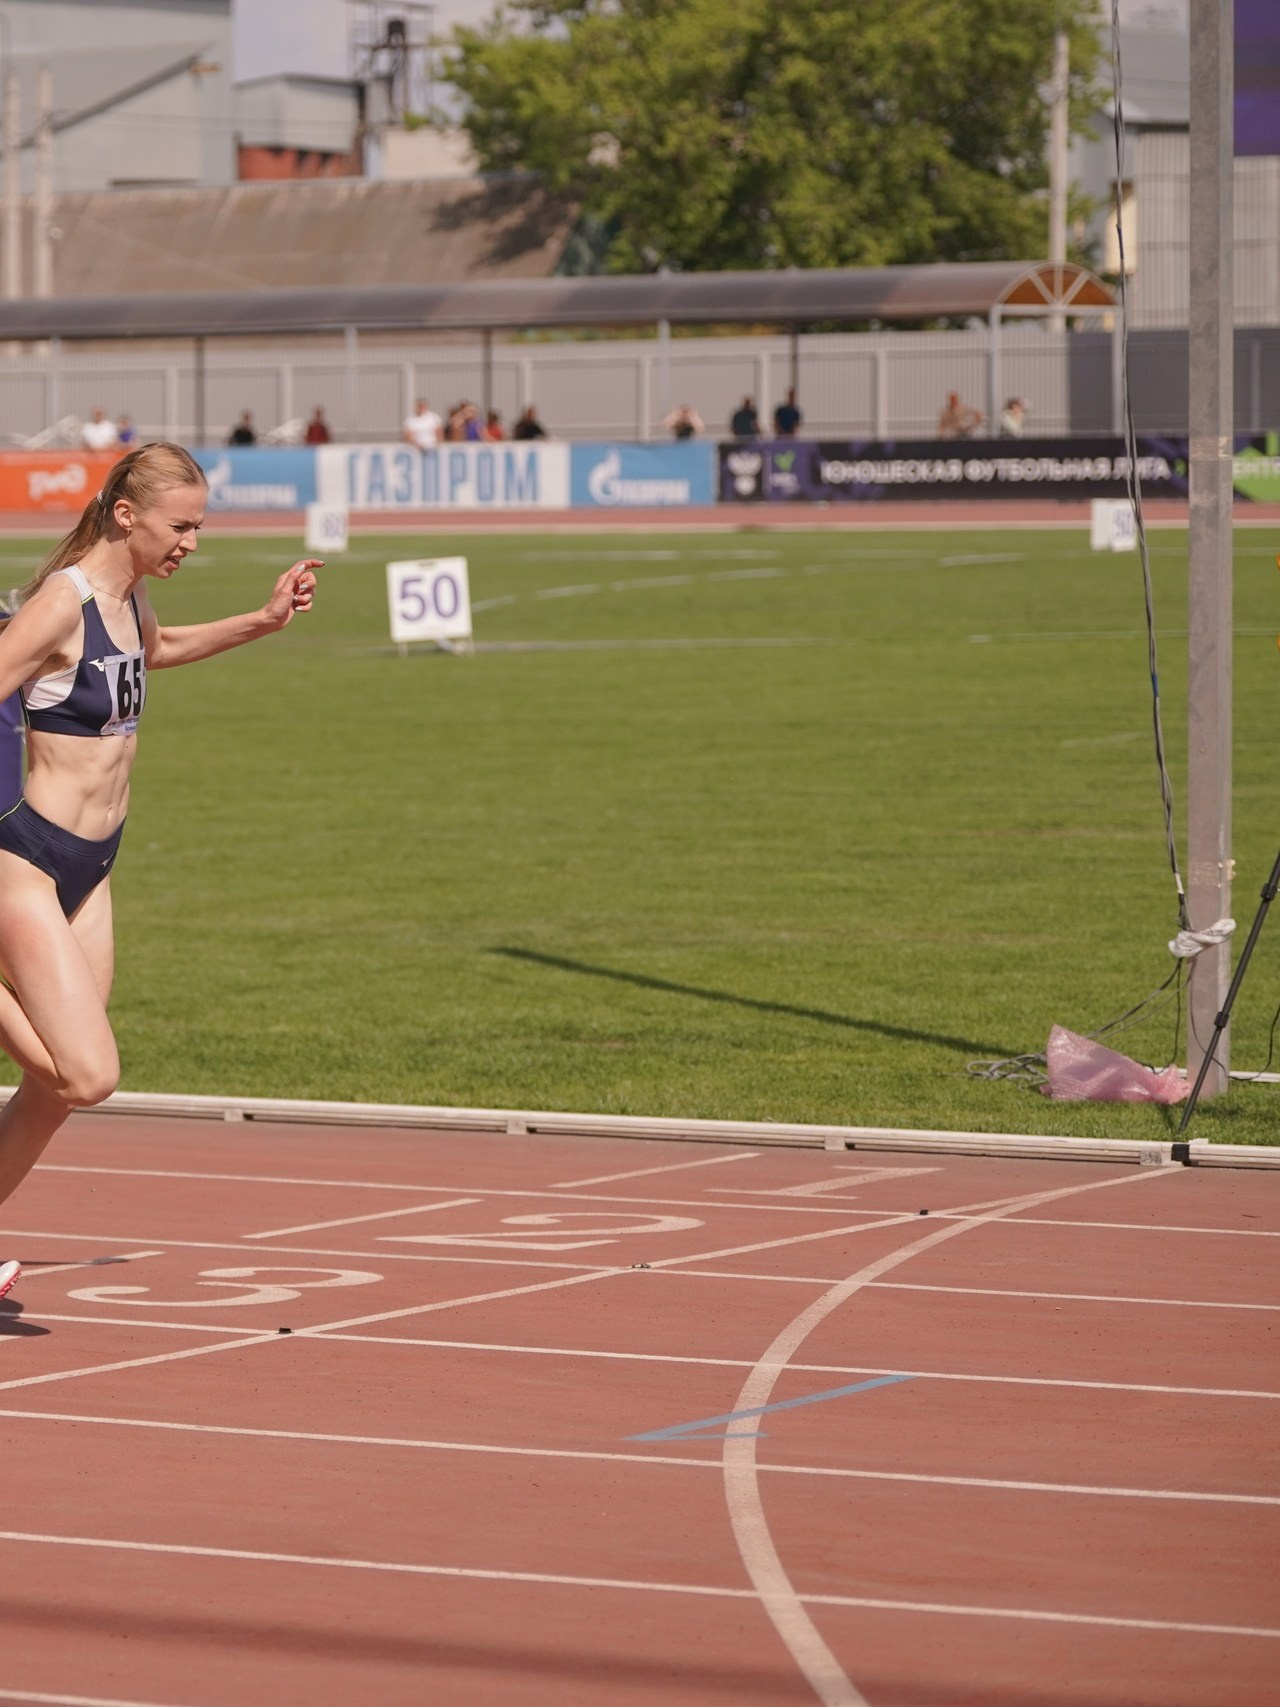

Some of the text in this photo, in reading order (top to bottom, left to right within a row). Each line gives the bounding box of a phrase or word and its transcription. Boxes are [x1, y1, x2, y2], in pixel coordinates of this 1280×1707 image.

[349, 450, 539, 508] ГАЗПРОМ
[821, 459, 963, 485] ЮНОШЕСКАЯ
[964, 456, 1112, 482] ФУТБОЛЬНАЯ
[399, 573, 460, 623] 50
[116, 653, 147, 720] 65
[704, 1165, 945, 1200] 1
[375, 1210, 706, 1252] 2
[65, 1265, 384, 1308] 3
